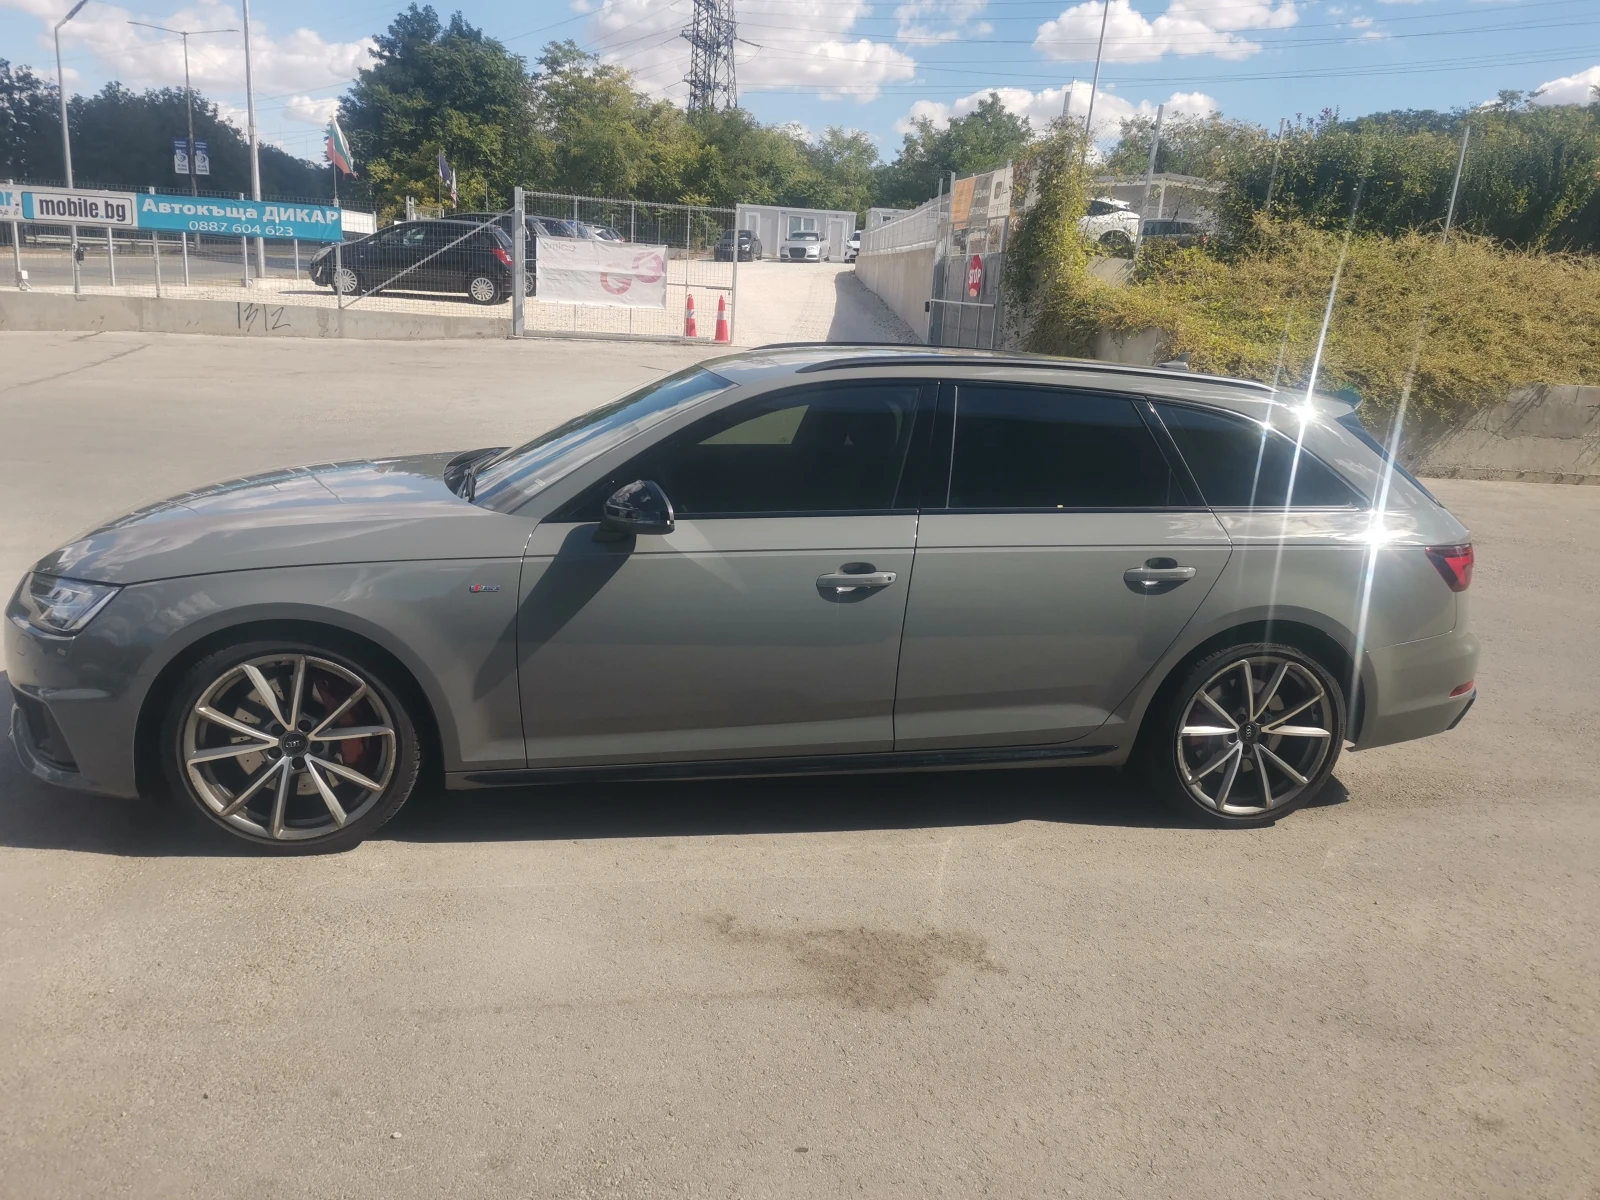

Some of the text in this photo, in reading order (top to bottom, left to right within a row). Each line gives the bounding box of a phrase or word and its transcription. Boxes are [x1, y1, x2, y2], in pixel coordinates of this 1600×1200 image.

[39, 198, 126, 222] mobile.bg
[142, 199, 339, 225] Автокъща ДИКАР
[189, 220, 294, 237] 0887 604 623
[970, 268, 981, 284] STOP
[237, 302, 291, 332] 1312
